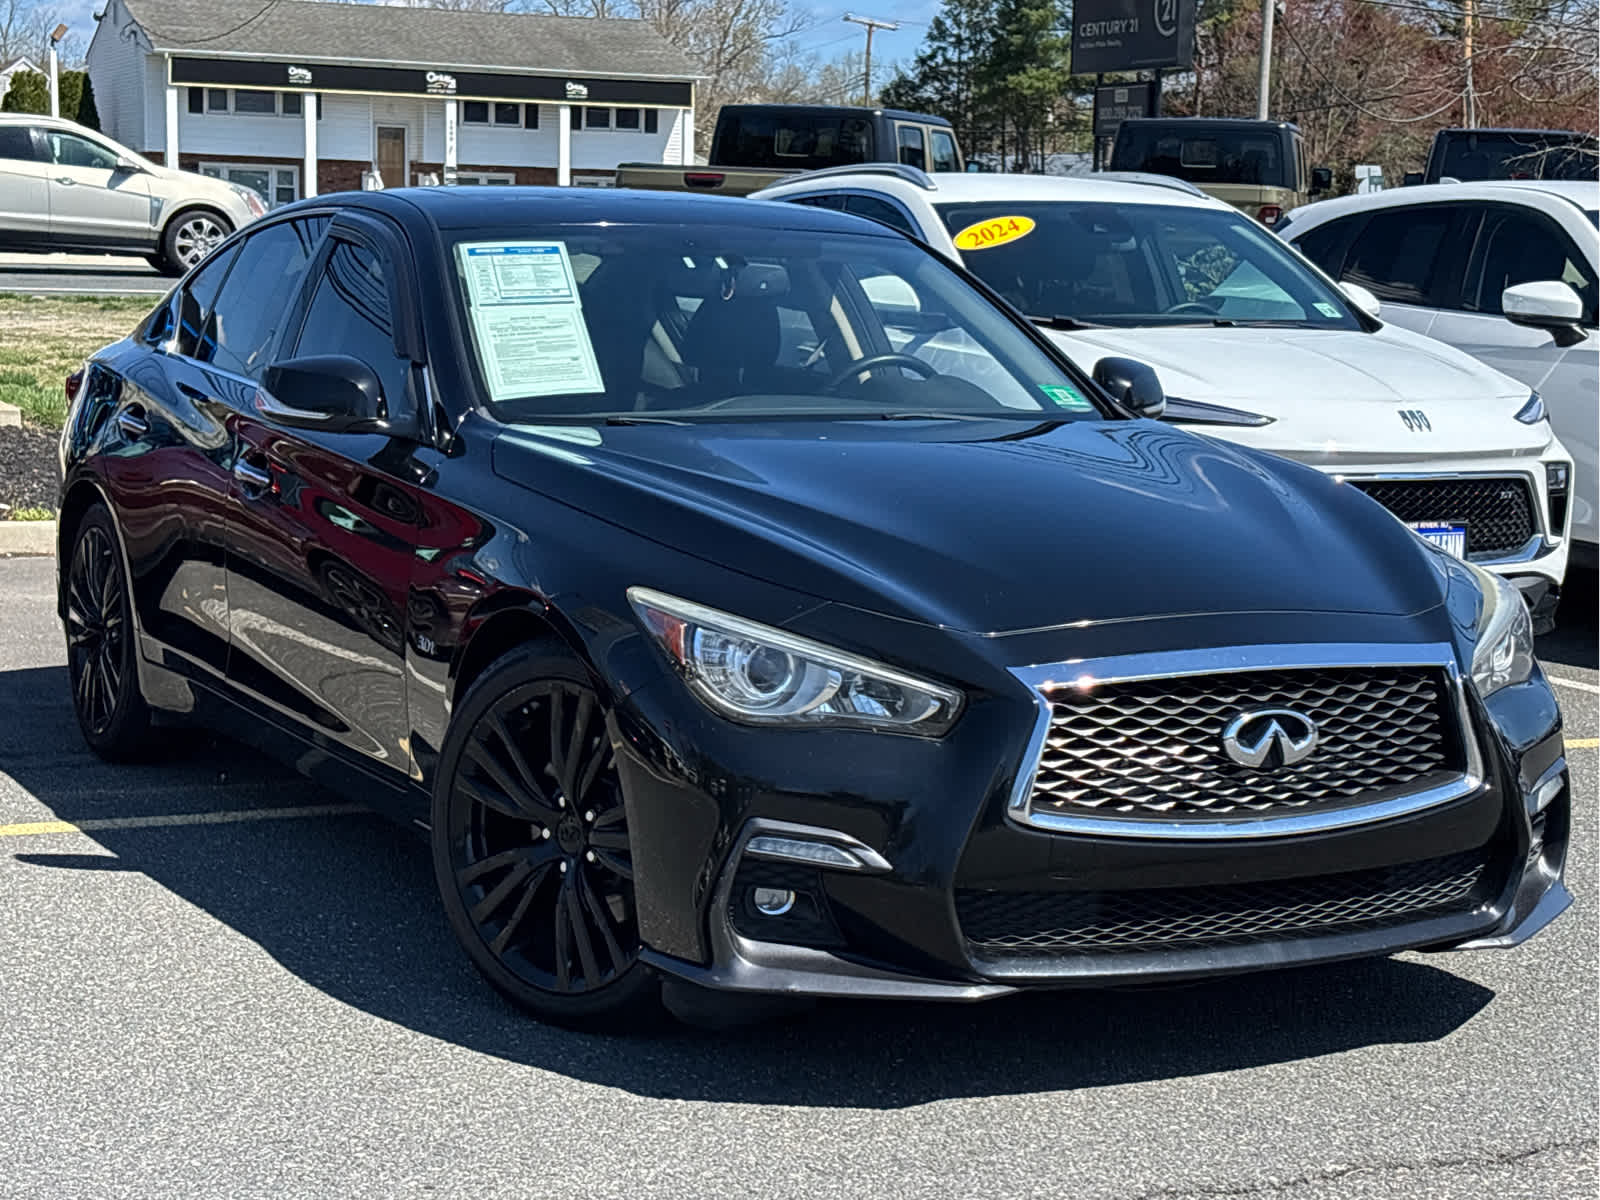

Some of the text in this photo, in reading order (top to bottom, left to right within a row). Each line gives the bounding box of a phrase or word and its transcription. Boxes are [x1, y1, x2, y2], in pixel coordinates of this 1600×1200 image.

[1080, 17, 1139, 37] CENTURY 21
[967, 219, 1020, 247] 2024
